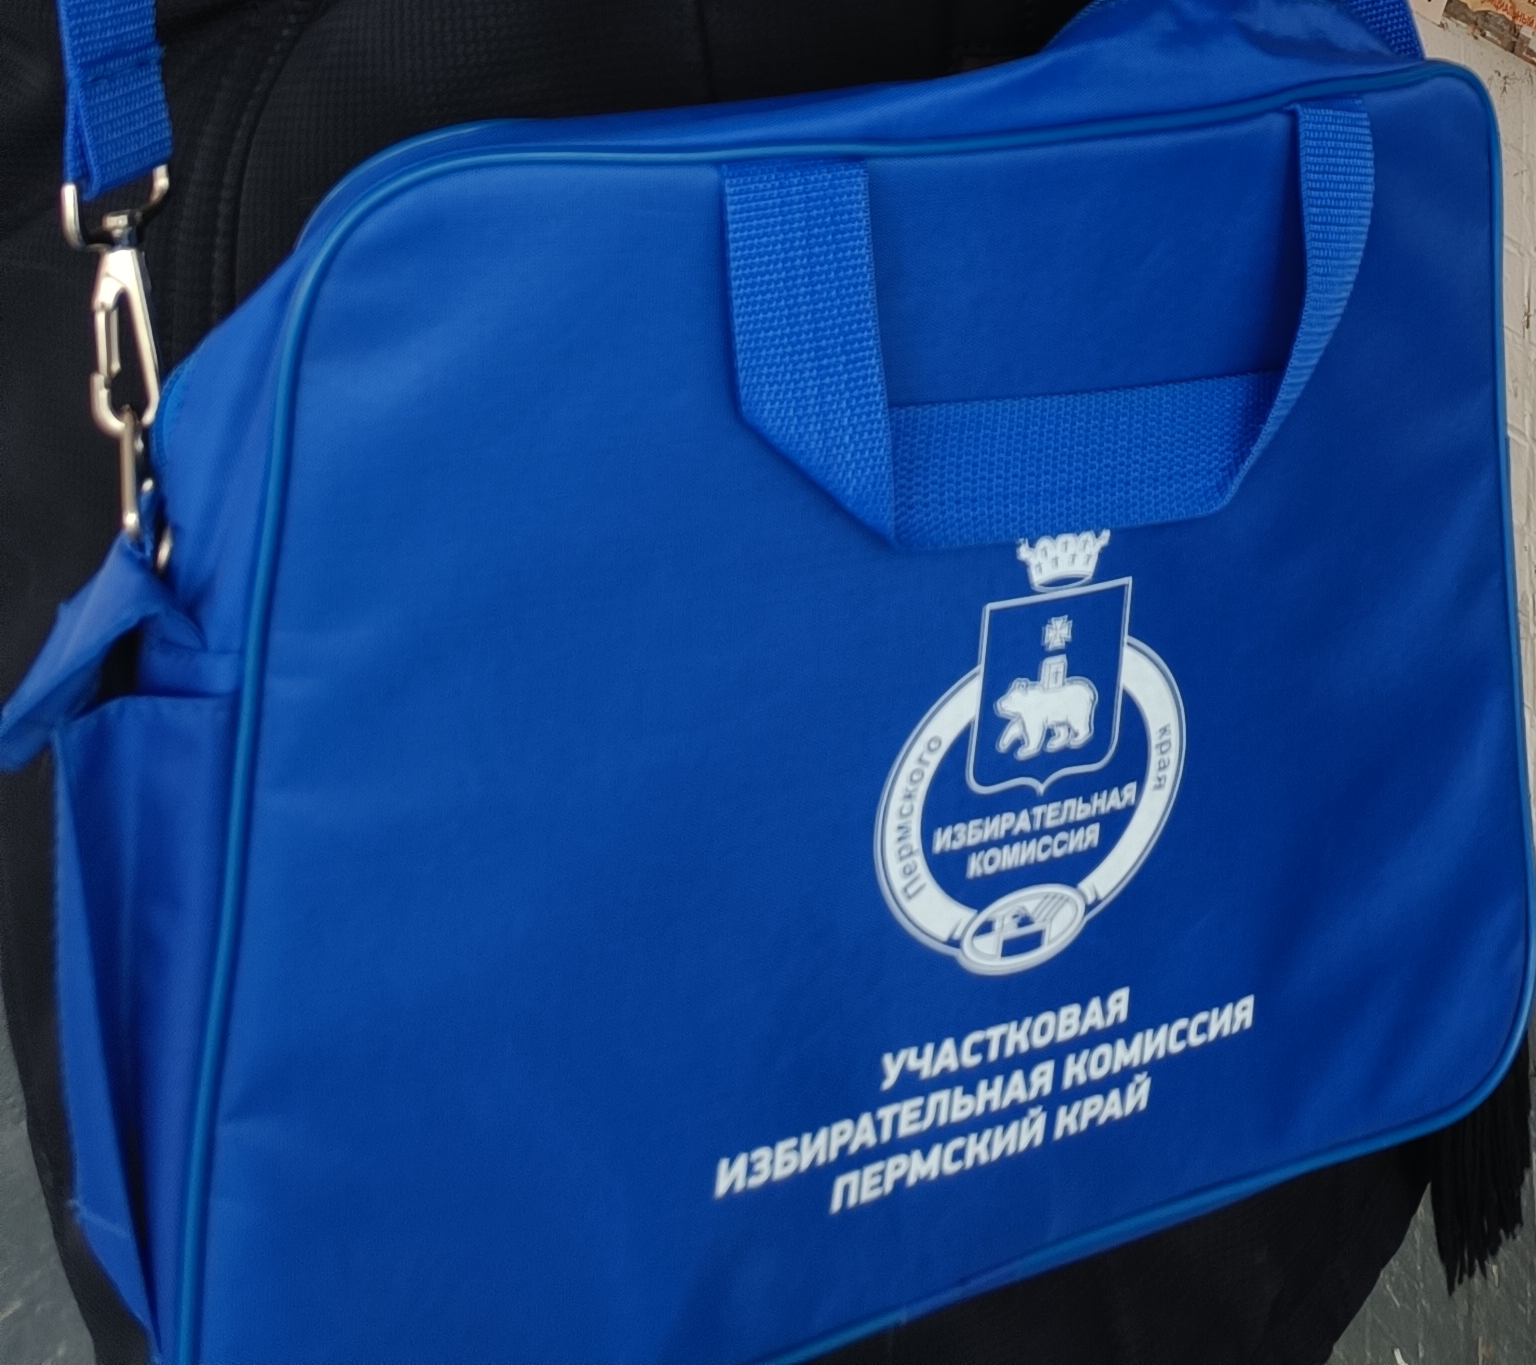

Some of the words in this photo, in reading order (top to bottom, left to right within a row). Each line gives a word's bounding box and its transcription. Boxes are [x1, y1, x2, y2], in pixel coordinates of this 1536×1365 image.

[932, 781, 1138, 855] ИЗБИРАТЕЛЬНАЯ
[966, 822, 1101, 880] КОМИССИЯ
[881, 986, 1131, 1091] УЧАСТКОВАЯ
[713, 1059, 1056, 1200] ИЗБИРАТЕЛЬНАЯ
[1062, 994, 1256, 1100] КОМИССИЯ
[829, 1105, 1044, 1215] ПЕРМСКИЙ
[1053, 1071, 1152, 1142] КРАЙ
